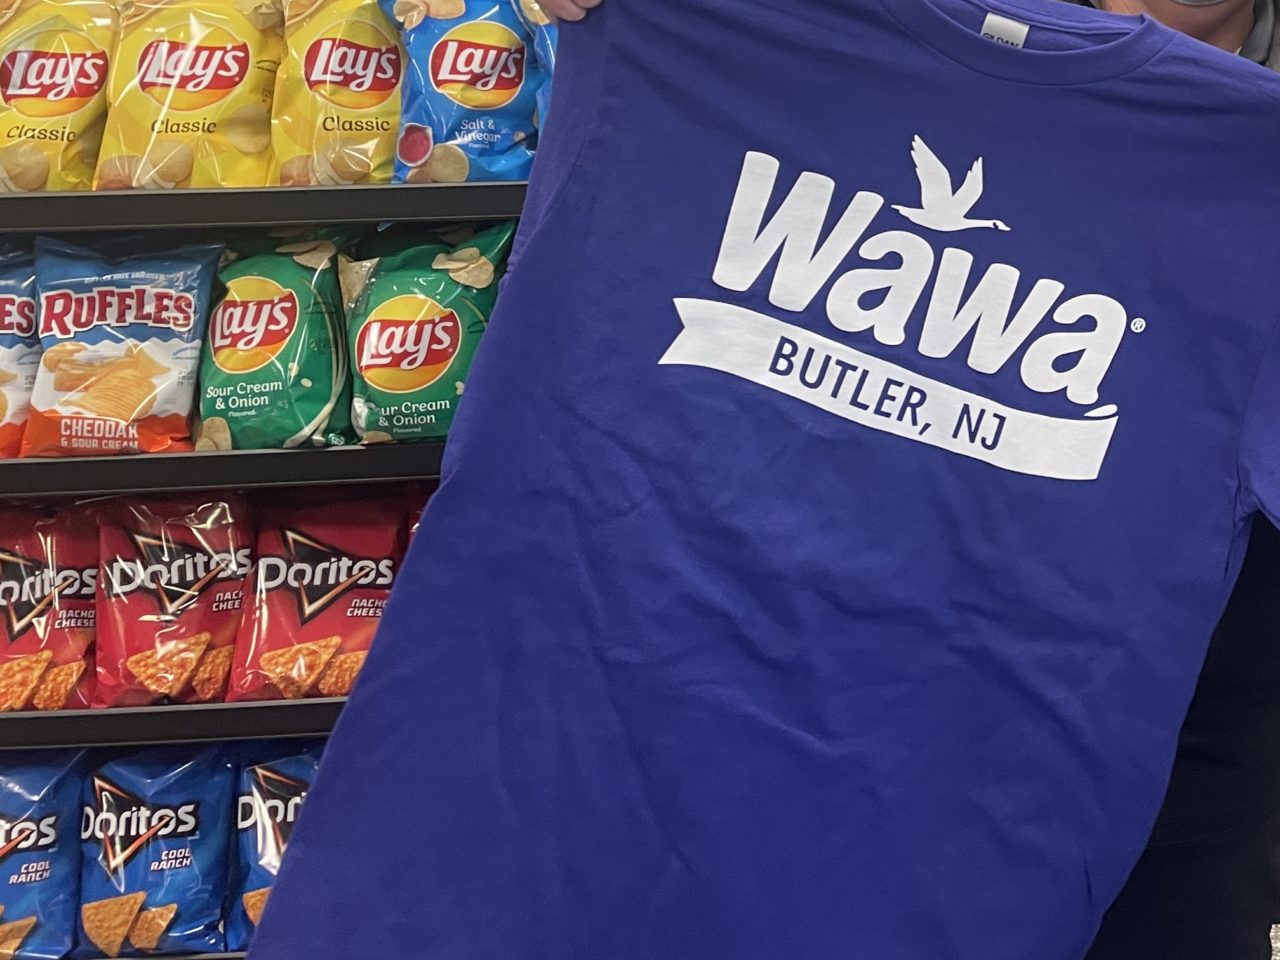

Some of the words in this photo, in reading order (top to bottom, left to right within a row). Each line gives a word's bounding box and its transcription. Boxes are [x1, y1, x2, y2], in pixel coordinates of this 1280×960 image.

[143, 41, 245, 92] Lay's
[310, 39, 398, 92] Lay's
[437, 40, 522, 91] Lay's
[6, 51, 105, 102] Lay's
[6, 124, 77, 143] Classic
[151, 117, 217, 135] Classic
[322, 116, 390, 132] Classic
[460, 118, 486, 130] Salt
[487, 119, 496, 130] &
[712, 150, 1128, 405] Wawa
[41, 287, 194, 337] RUFFLES
[214, 296, 293, 350] Lay's
[360, 316, 454, 370] Lay's
[205, 384, 234, 399] Sour
[236, 379, 283, 395] Cream
[767, 334, 933, 437] BUTLER,
[951, 402, 1008, 452] NJ
[215, 397, 226, 409] &
[228, 394, 269, 408] Onion
[401, 399, 451, 414] Cream
[60, 417, 139, 438] CHEDDAR
[378, 415, 390, 427] &
[393, 413, 436, 426] Onion
[72, 437, 99, 449] SOUR
[101, 439, 139, 450] CREAM
[112, 548, 252, 595] Doritos
[259, 555, 394, 589] Doritos
[0, 567, 99, 607] oritos
[58, 609, 95, 619] NACHO
[212, 599, 241, 611] CHEE
[346, 608, 383, 617] CHEES
[54, 618, 96, 628] CHEESE
[81, 802, 197, 840] Doritos
[160, 847, 191, 861] COOL
[21, 859, 51, 873] COOL
[150, 857, 192, 872] RANCH
[9, 870, 51, 885] RANCH
